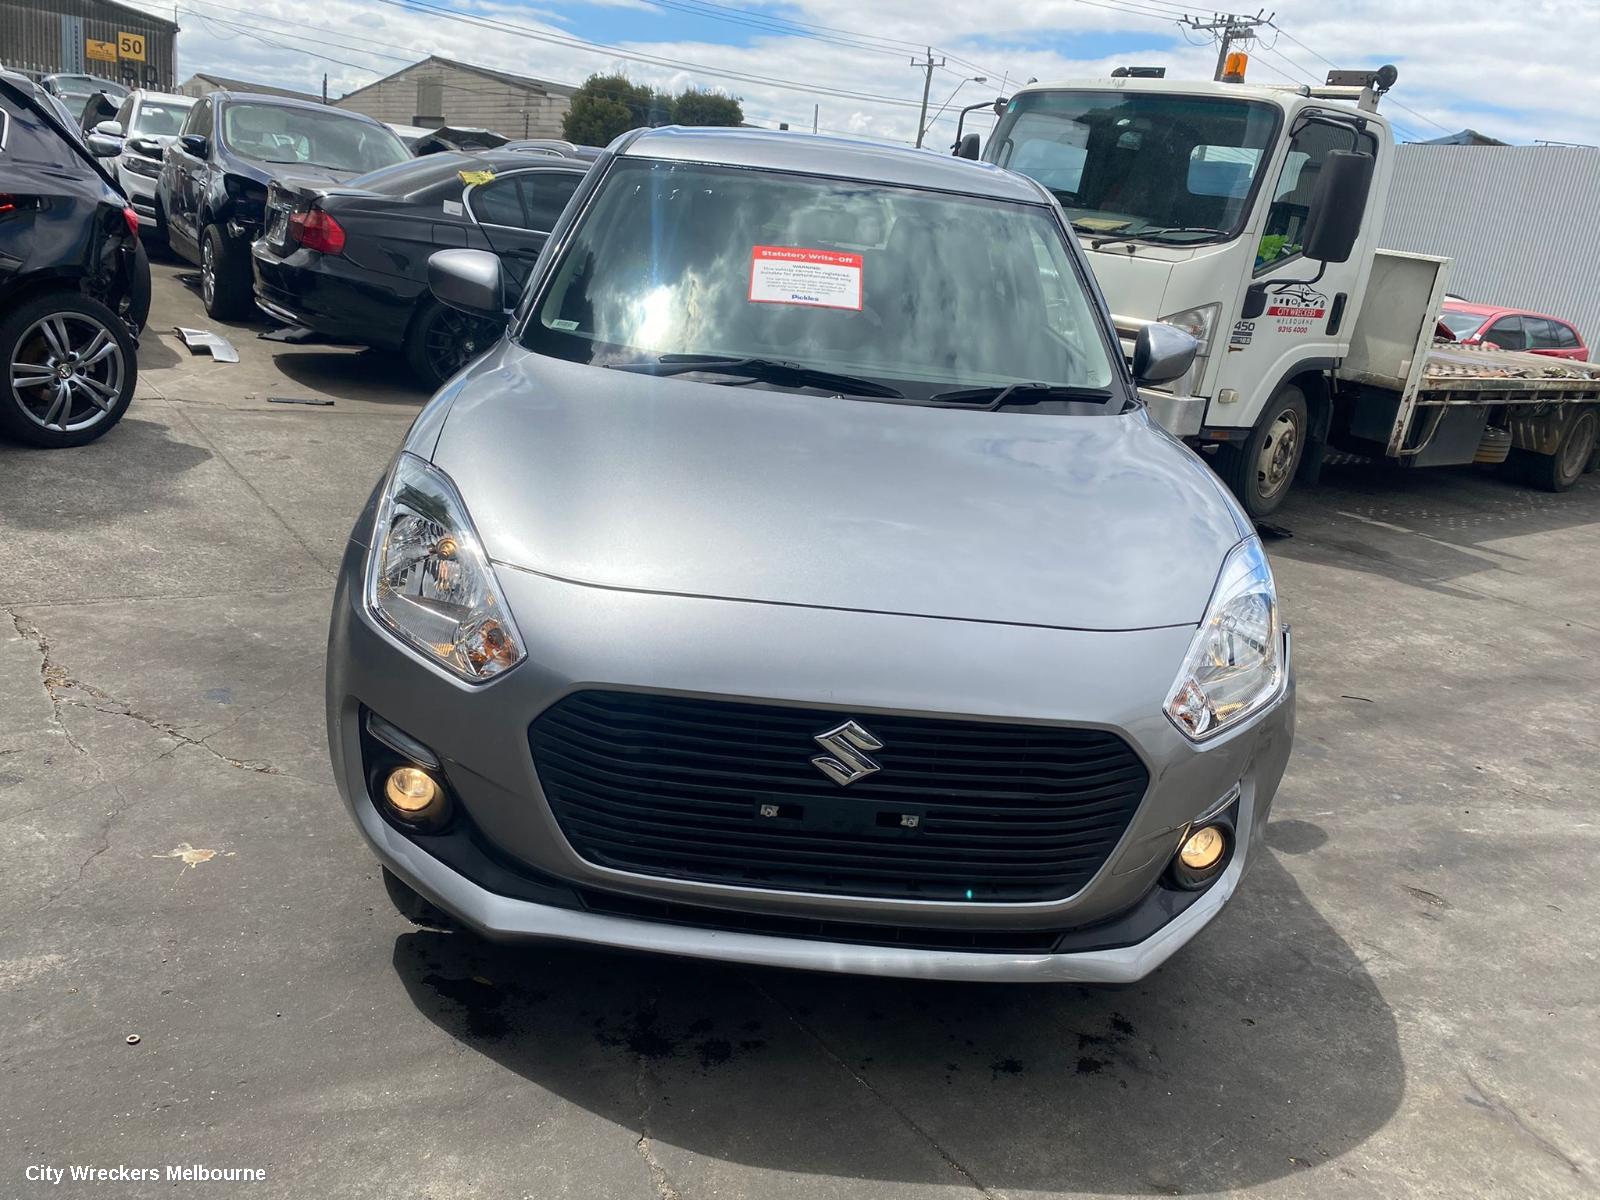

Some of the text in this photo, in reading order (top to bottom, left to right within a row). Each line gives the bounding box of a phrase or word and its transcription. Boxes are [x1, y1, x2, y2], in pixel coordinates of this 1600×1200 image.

[121, 38, 142, 54] 50
[762, 250, 853, 263] Statutory Write-Off
[792, 294, 819, 302] Pickles
[1277, 308, 1316, 317] CITY WRECKERS
[1235, 321, 1255, 331] 450
[1278, 326, 1293, 334] 9315
